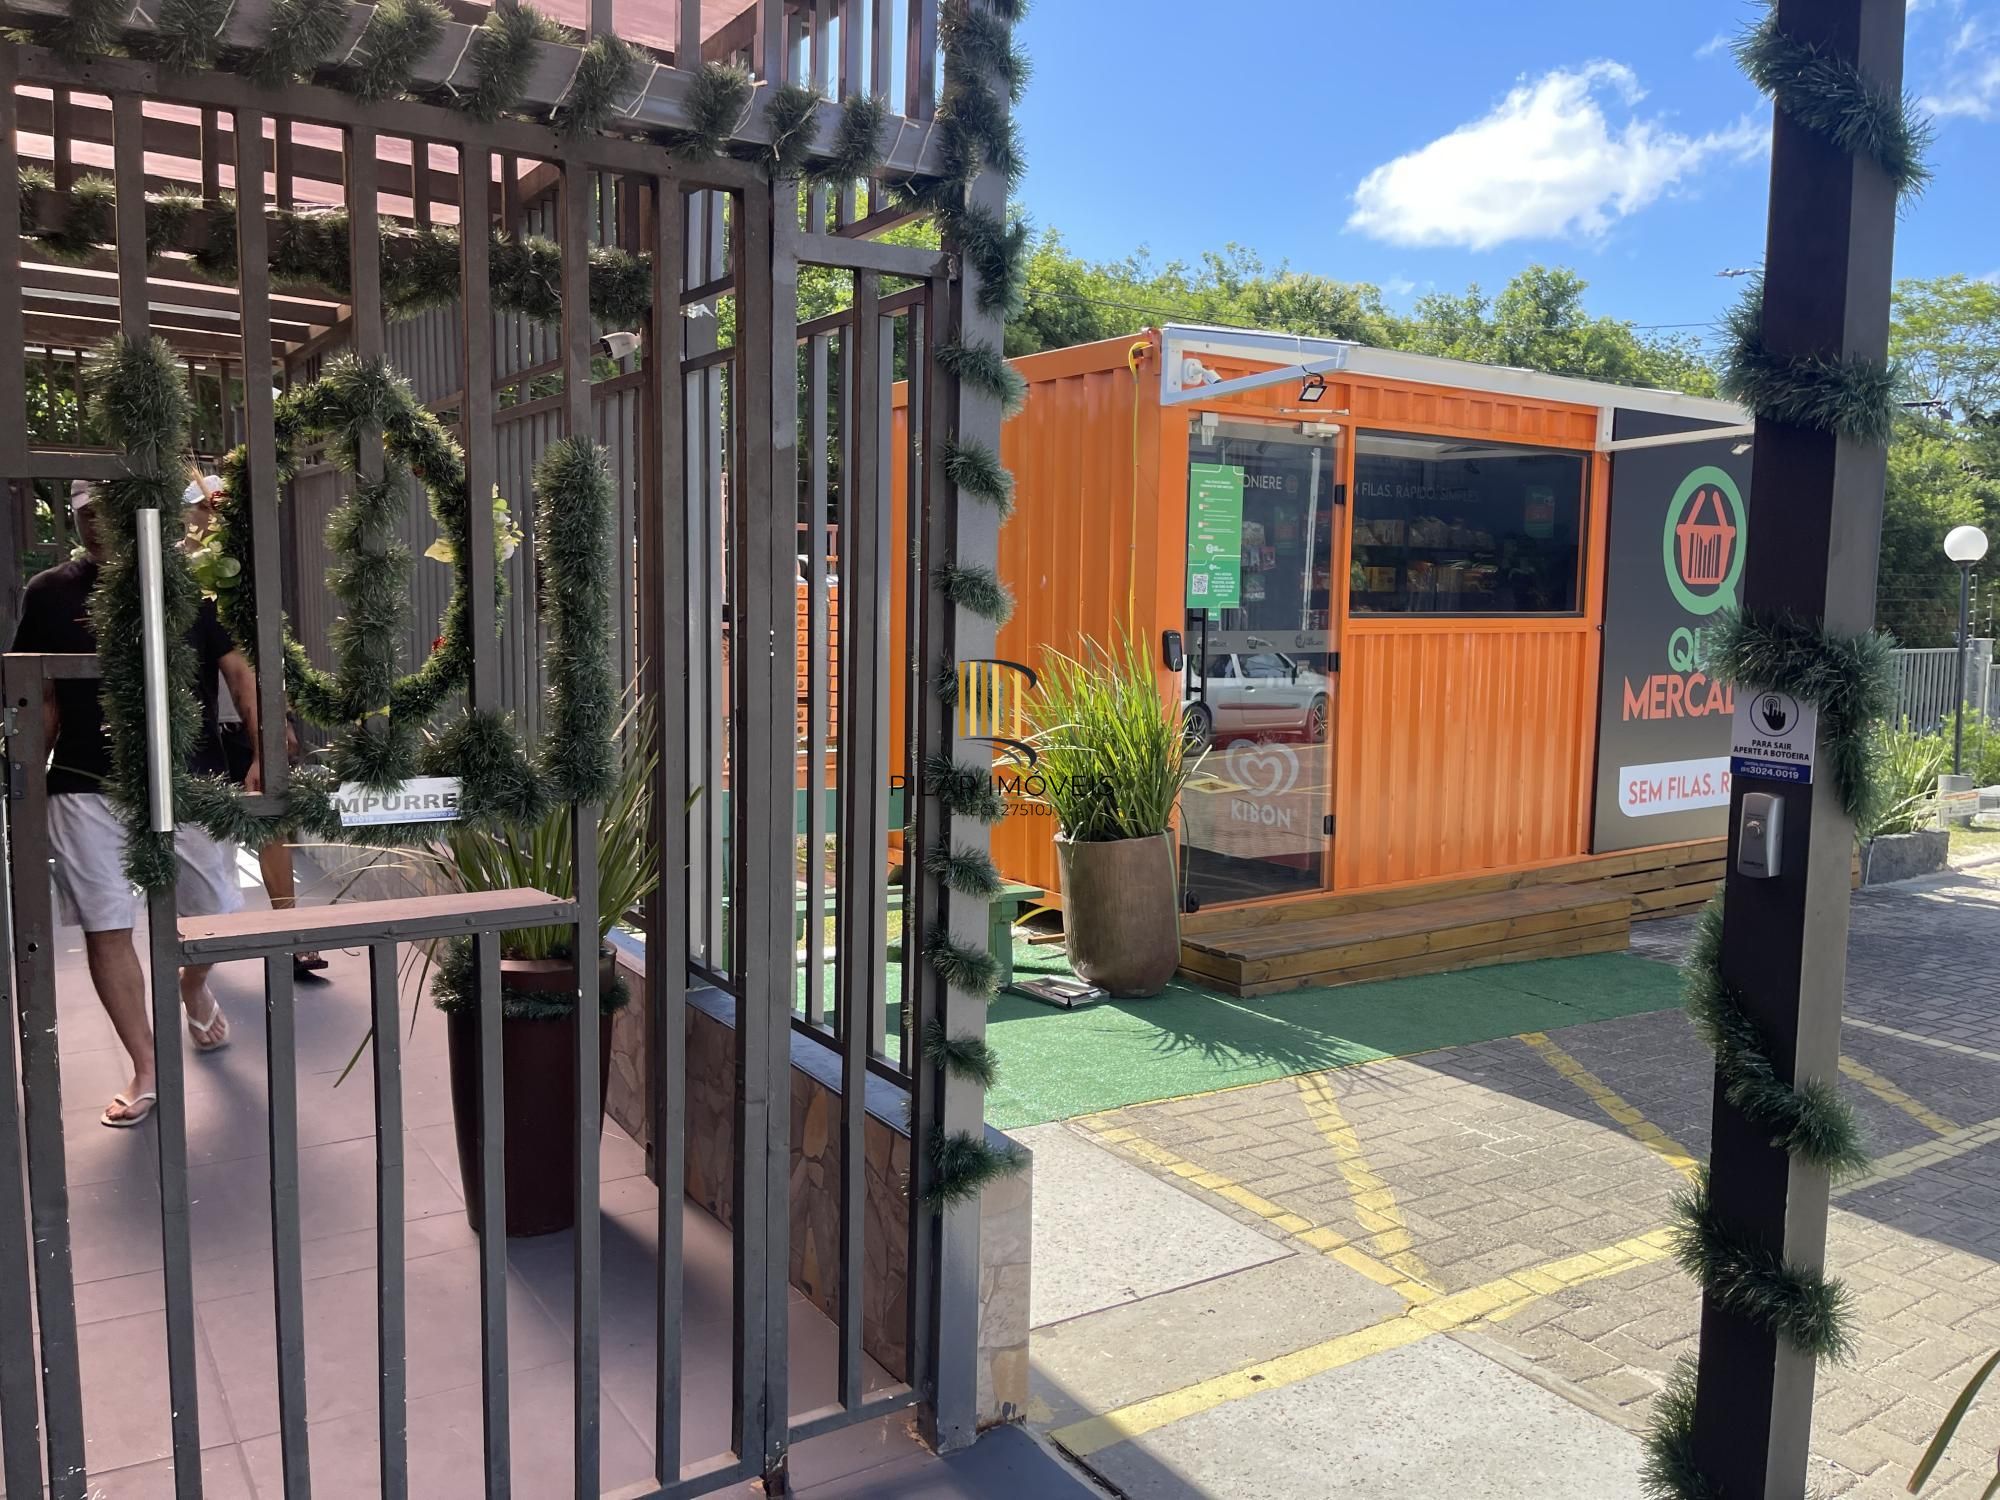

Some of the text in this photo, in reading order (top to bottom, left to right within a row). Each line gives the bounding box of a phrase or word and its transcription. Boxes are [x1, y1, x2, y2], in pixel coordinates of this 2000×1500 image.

[1733, 745, 1810, 761] APERTE A BOTOEIRA
[1751, 739, 1792, 751] PARA SAIR
[1628, 779, 1663, 806] SEM
[1667, 772, 1715, 801] FILAS.
[1231, 798, 1292, 830] KIBON
